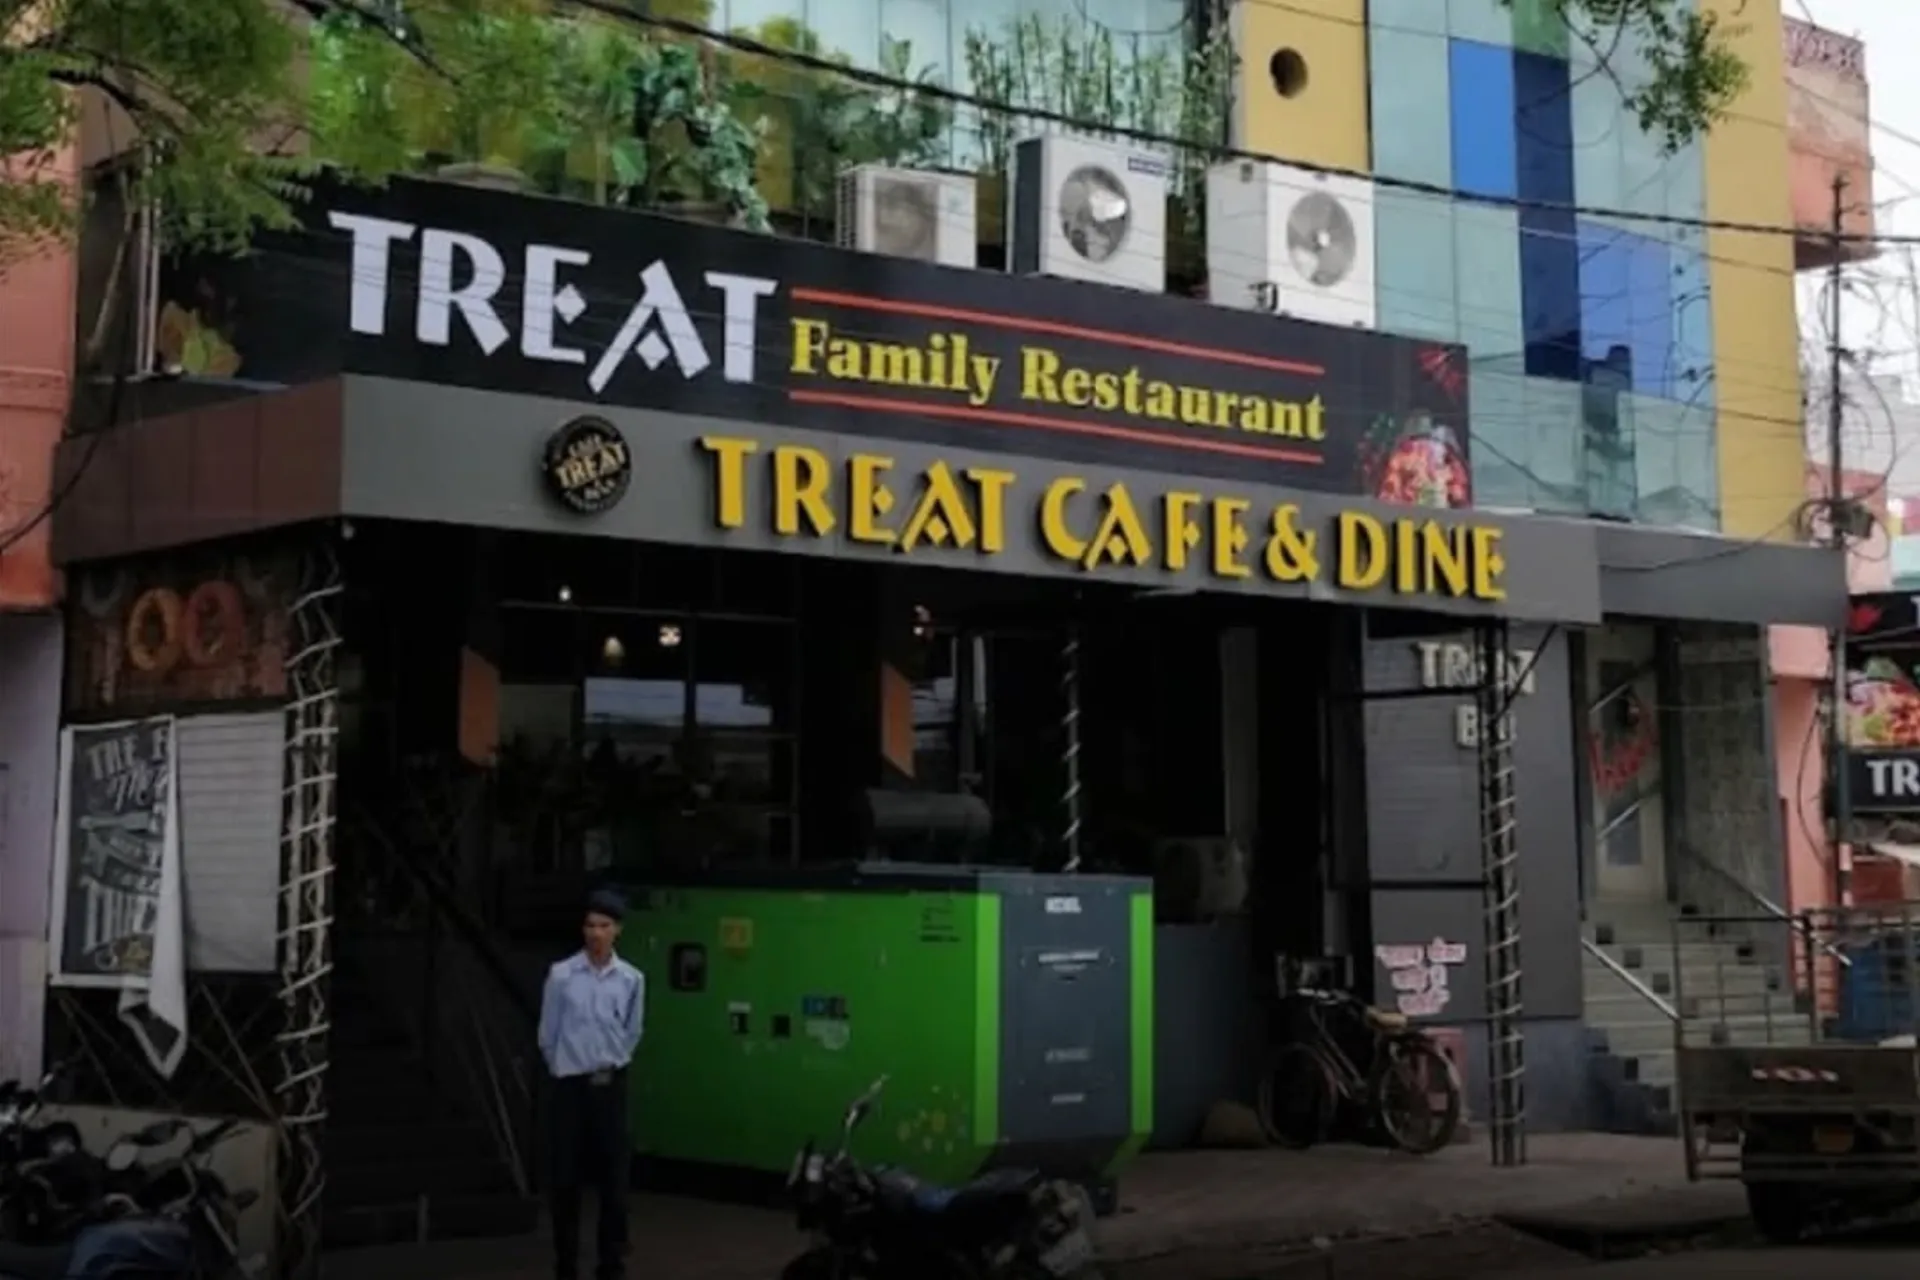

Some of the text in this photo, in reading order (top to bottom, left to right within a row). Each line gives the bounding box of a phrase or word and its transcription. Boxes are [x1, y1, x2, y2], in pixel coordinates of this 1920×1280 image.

[328, 211, 777, 393] TREAT
[789, 316, 1327, 441] Family Restaurant
[700, 435, 1016, 554] TREAT
[1040, 476, 1251, 579] CAFE
[1337, 509, 1507, 600] DINE
